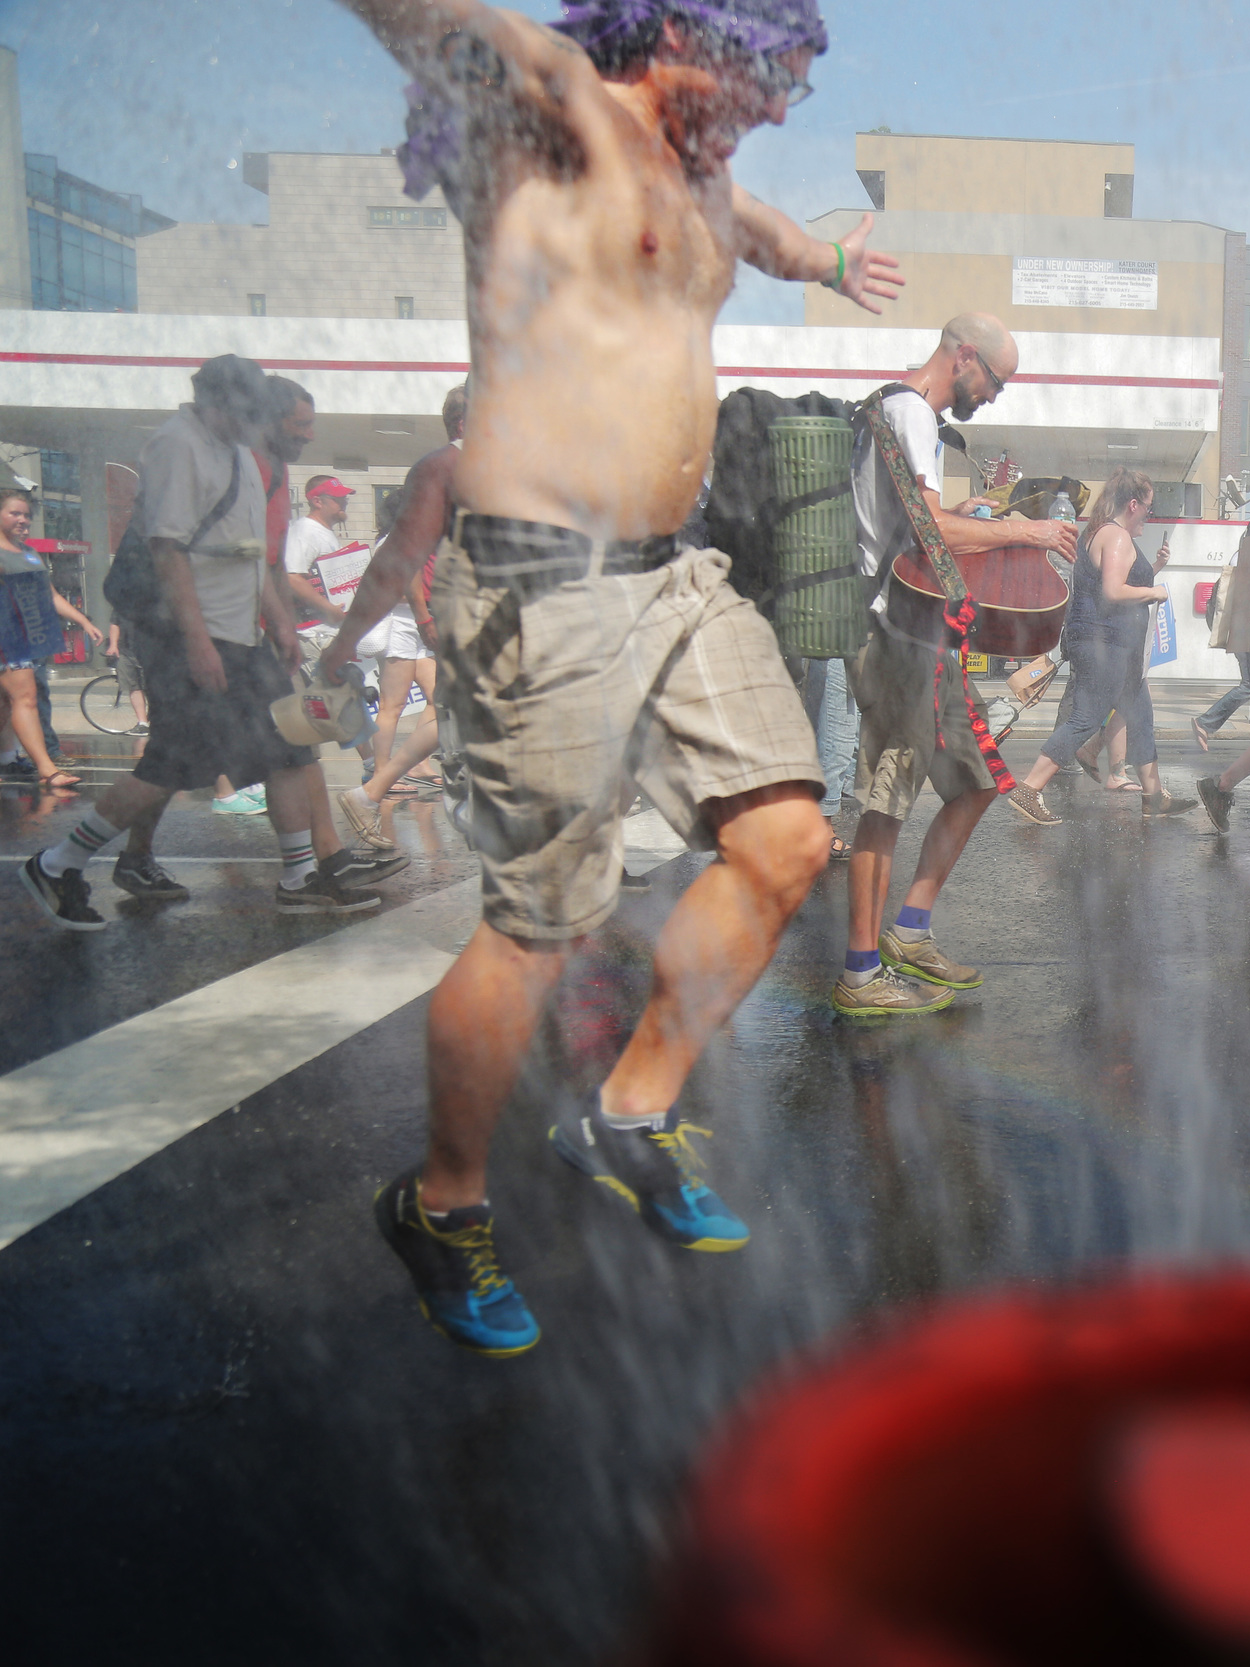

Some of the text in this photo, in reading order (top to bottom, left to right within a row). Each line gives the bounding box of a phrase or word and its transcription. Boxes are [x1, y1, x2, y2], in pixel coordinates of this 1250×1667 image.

[1017, 259, 1114, 272] UNDER NEW OWNERSHIP!
[1207, 552, 1223, 561] 615
[17, 582, 47, 645] Bernie
